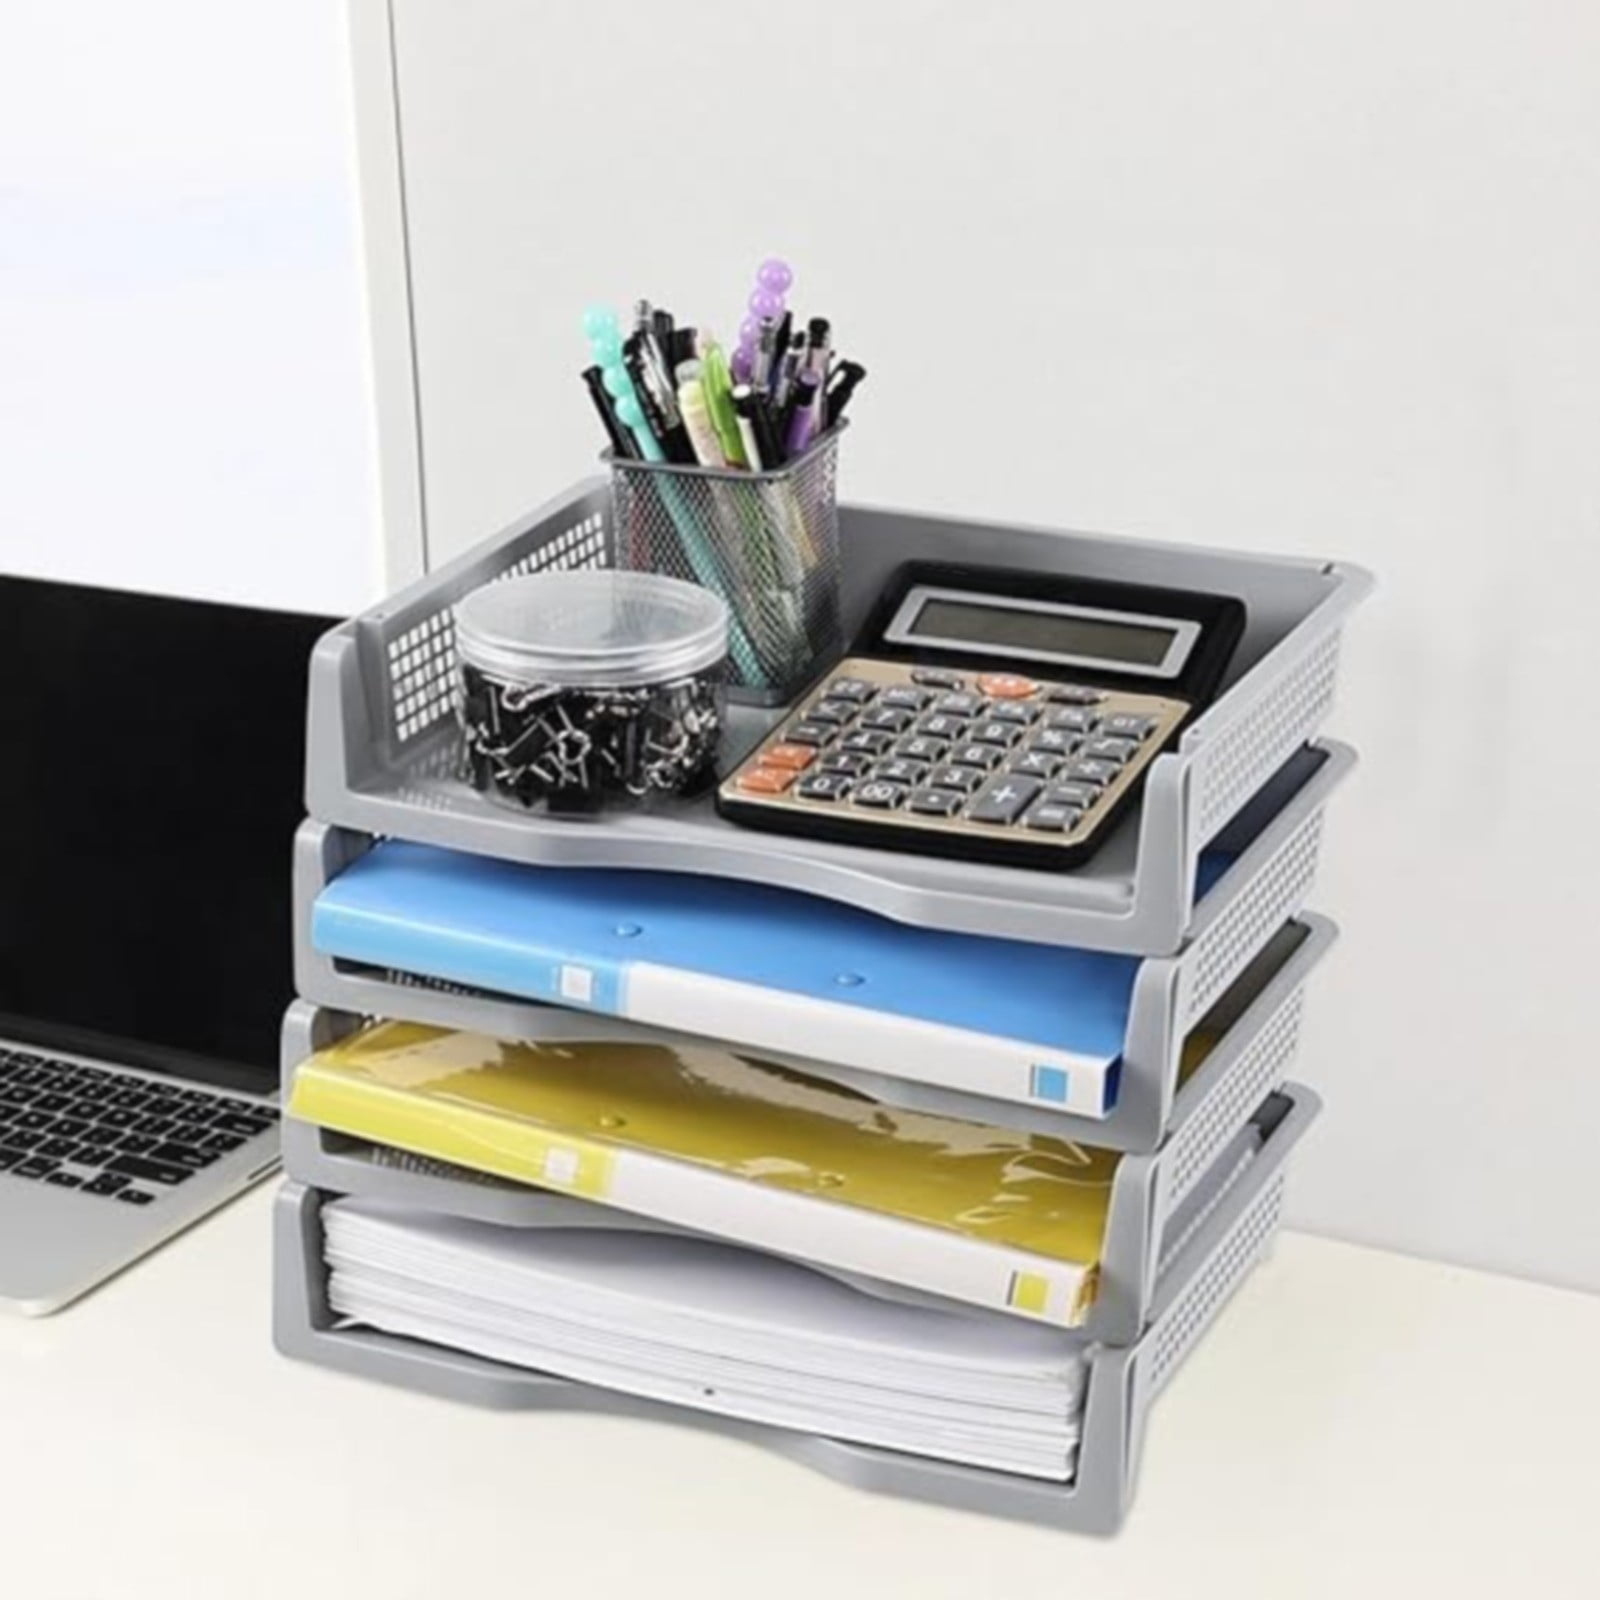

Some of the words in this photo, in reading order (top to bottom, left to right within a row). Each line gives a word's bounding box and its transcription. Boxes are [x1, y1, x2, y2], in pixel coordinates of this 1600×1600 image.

[927, 717, 946, 731] 8
[984, 724, 1003, 738] 9
[853, 733, 870, 746] 4
[965, 747, 983, 760] 6
[888, 761, 907, 775] 2
[812, 777, 832, 791] 0
[944, 771, 963, 784] 3
